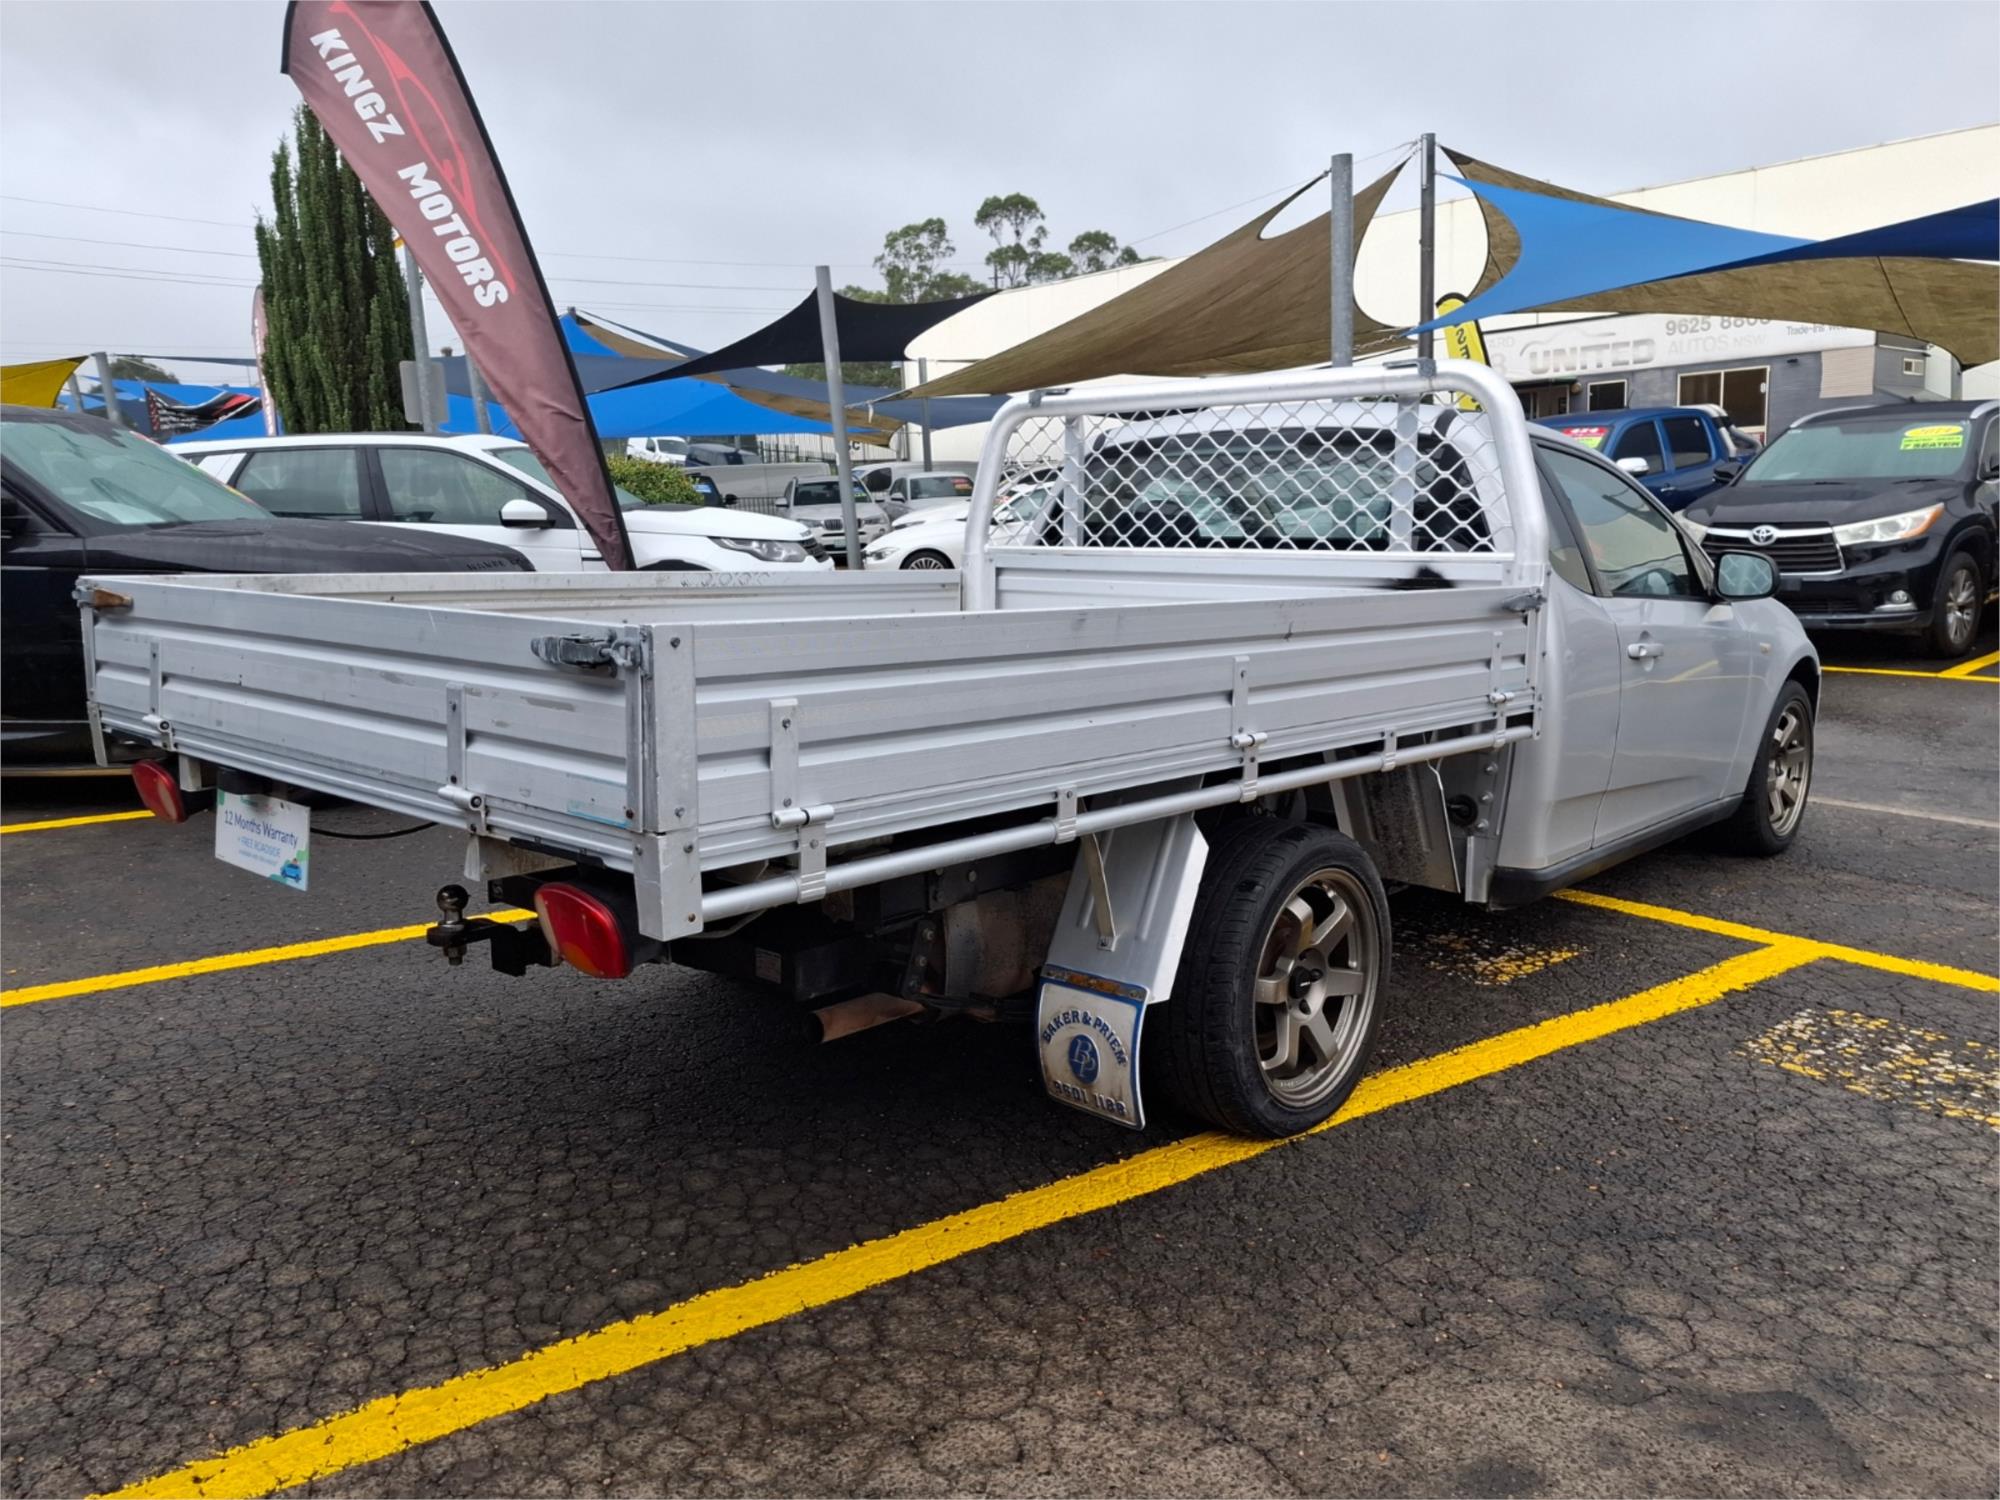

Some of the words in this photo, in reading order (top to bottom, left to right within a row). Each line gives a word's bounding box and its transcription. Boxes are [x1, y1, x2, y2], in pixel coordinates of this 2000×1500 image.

[310, 28, 405, 144] KINGZ
[397, 162, 509, 307] MOTORS
[1665, 317, 1711, 336] 9625
[1529, 338, 1655, 375] UNITED
[1668, 334, 1728, 356] AUTOS
[224, 809, 234, 825] 12
[234, 814, 260, 834] Months
[262, 822, 298, 847] Warranty
[1042, 1010, 1081, 1045] BAKER
[1081, 1010, 1092, 1026] &
